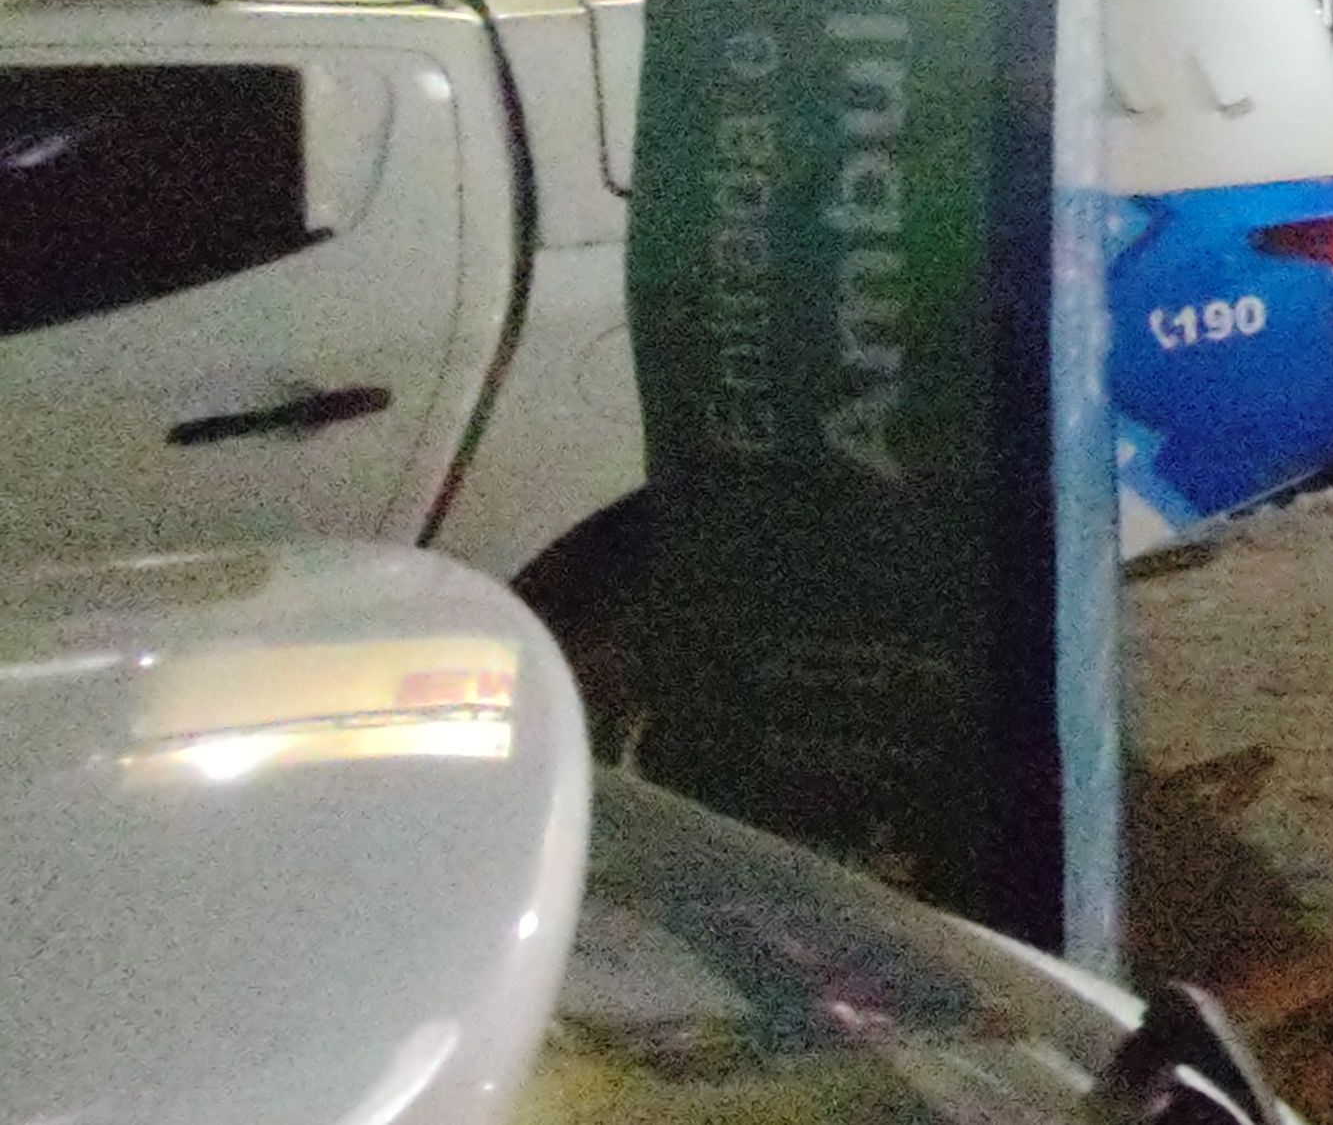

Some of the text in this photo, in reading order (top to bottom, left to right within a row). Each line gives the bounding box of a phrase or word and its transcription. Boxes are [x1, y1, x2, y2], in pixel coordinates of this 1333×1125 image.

[722, 27, 784, 81] e
[706, 113, 778, 455] Entrada
[1173, 295, 1267, 345] 190
